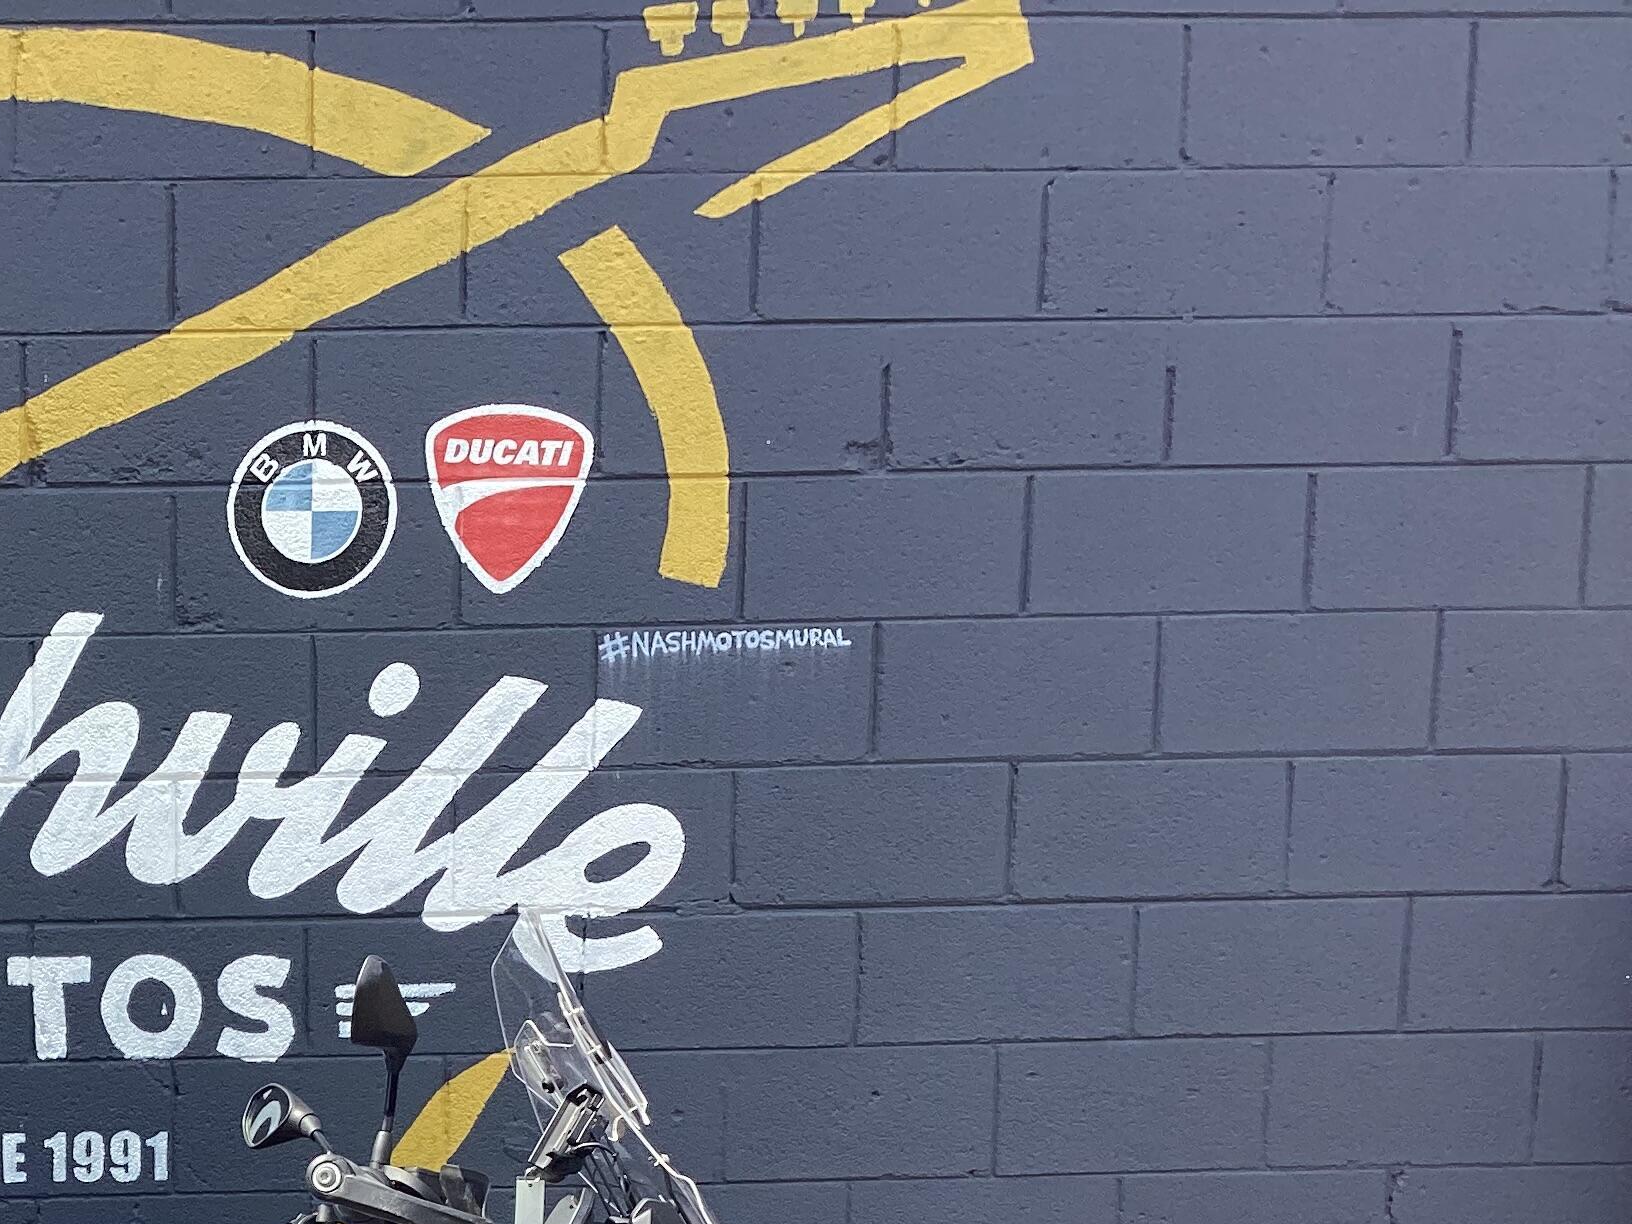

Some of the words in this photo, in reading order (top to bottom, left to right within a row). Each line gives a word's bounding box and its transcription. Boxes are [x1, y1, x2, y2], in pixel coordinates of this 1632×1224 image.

[249, 431, 379, 484] BMW
[444, 438, 574, 467] DUCATI
[599, 627, 852, 663] #NASHMOTOSMURAL
[42, 1129, 172, 1185] 1991
